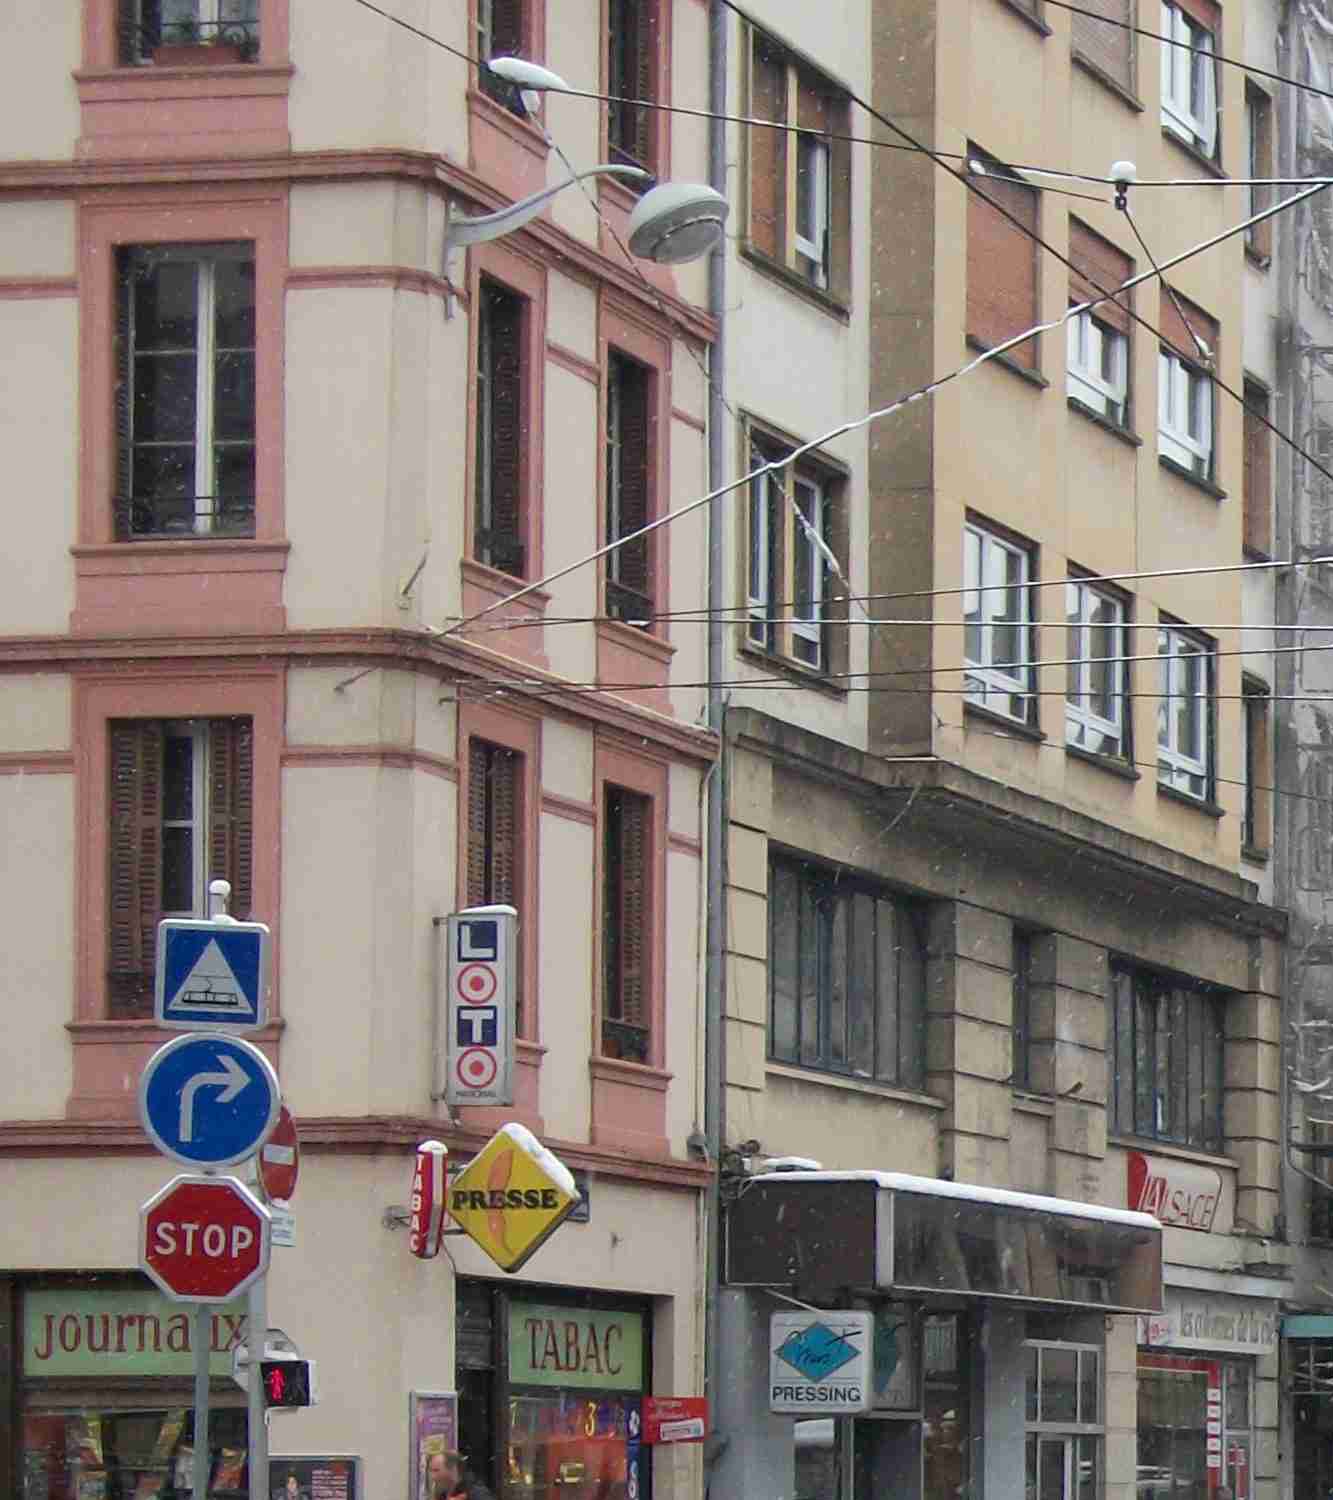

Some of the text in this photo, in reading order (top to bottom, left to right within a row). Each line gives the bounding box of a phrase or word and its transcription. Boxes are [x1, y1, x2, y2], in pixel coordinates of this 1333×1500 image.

[457, 922, 497, 1088] LOTO
[410, 1155, 425, 1253] TABAC
[452, 1189, 560, 1211] PRESSE
[154, 1222, 254, 1258] STOP
[525, 1318, 623, 1375] TABAC
[772, 1386, 861, 1402] PRESSING
